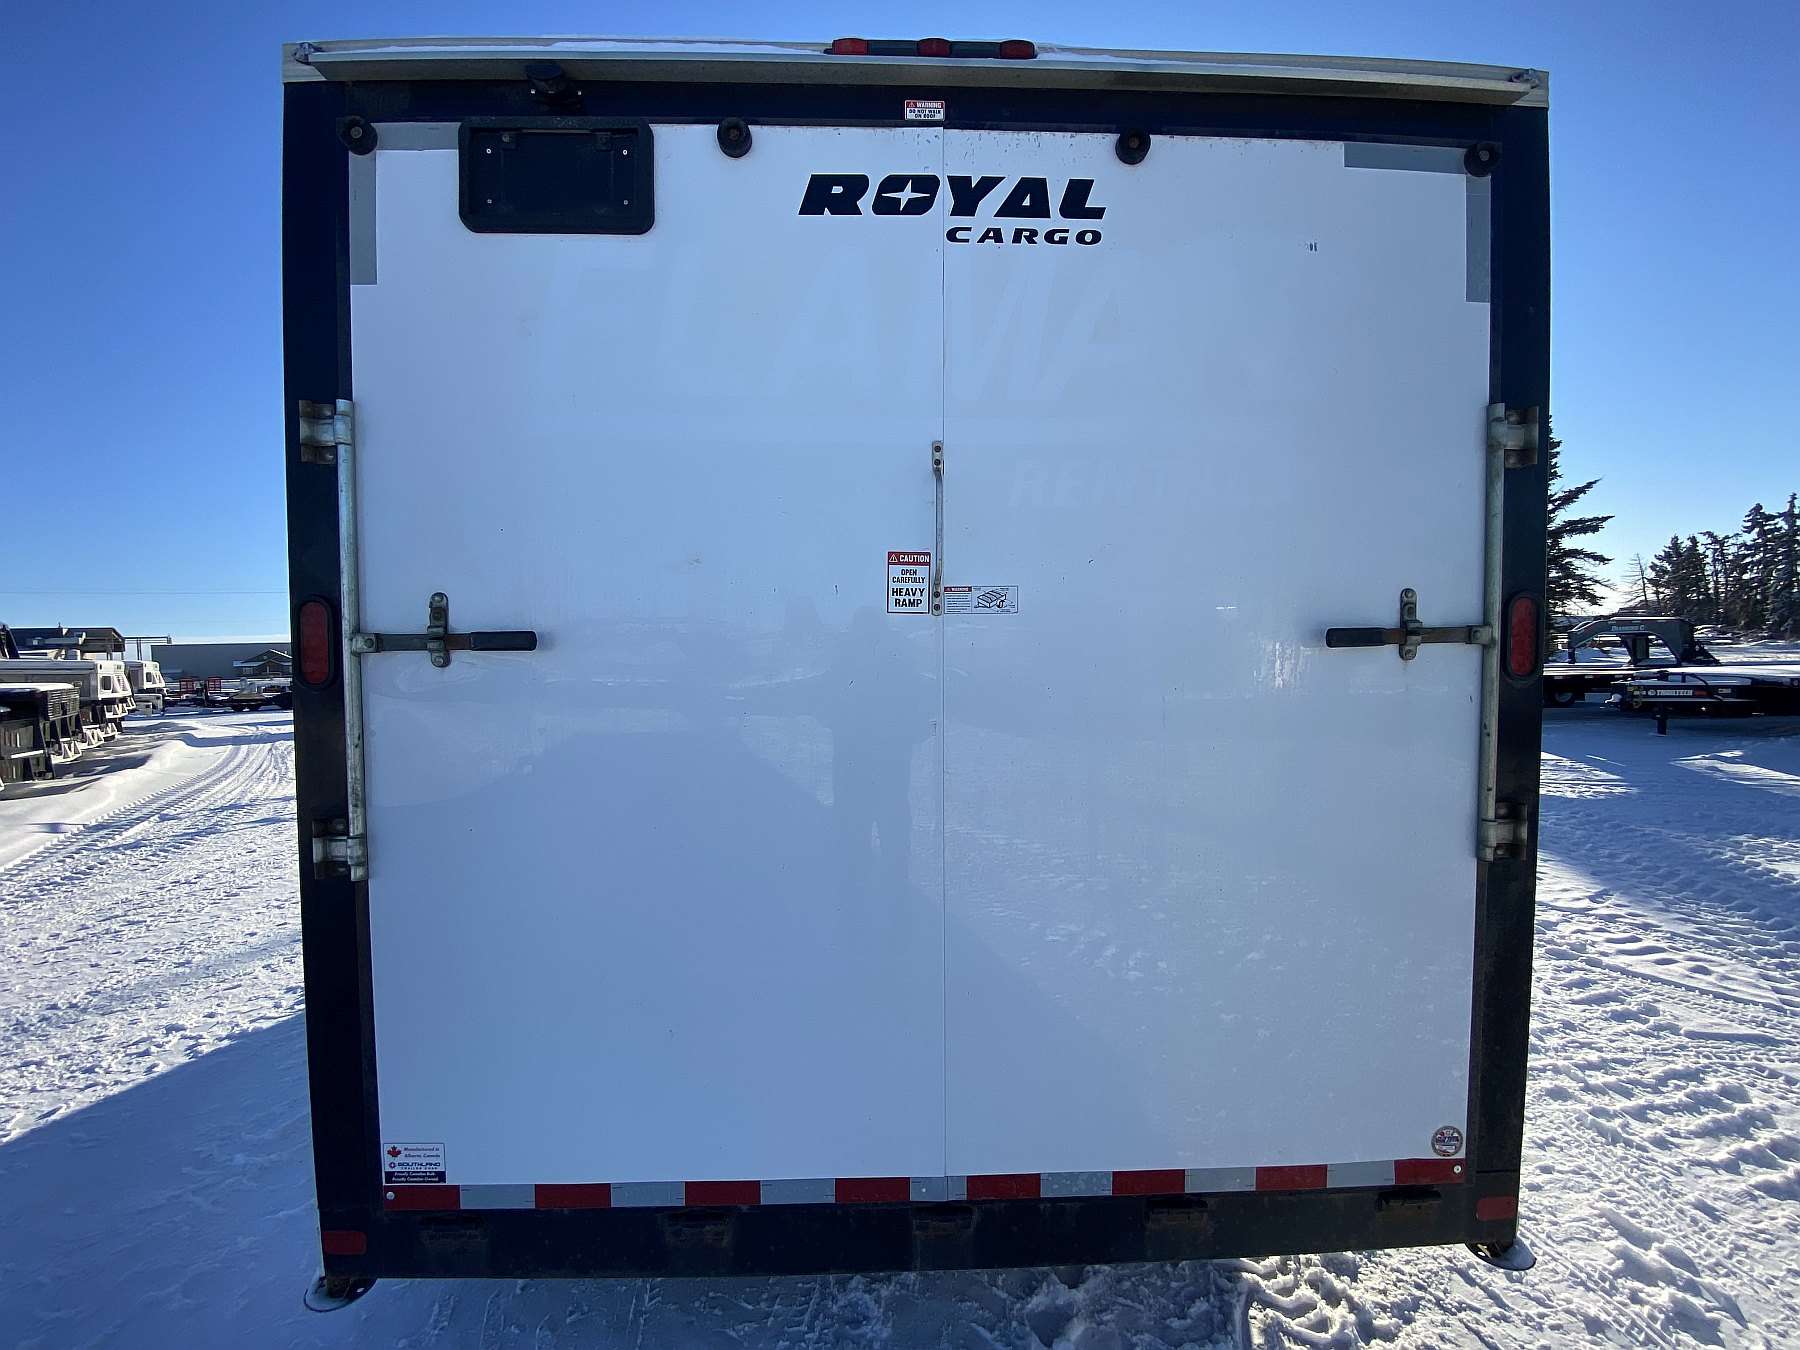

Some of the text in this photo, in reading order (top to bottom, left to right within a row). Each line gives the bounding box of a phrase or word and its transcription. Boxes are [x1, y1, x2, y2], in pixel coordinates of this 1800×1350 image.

[798, 174, 1107, 220] ROYAL
[946, 227, 1103, 245] CARGO
[899, 554, 930, 562] CAUTION
[891, 588, 926, 597] HEAVY
[894, 599, 923, 608] RAMP
